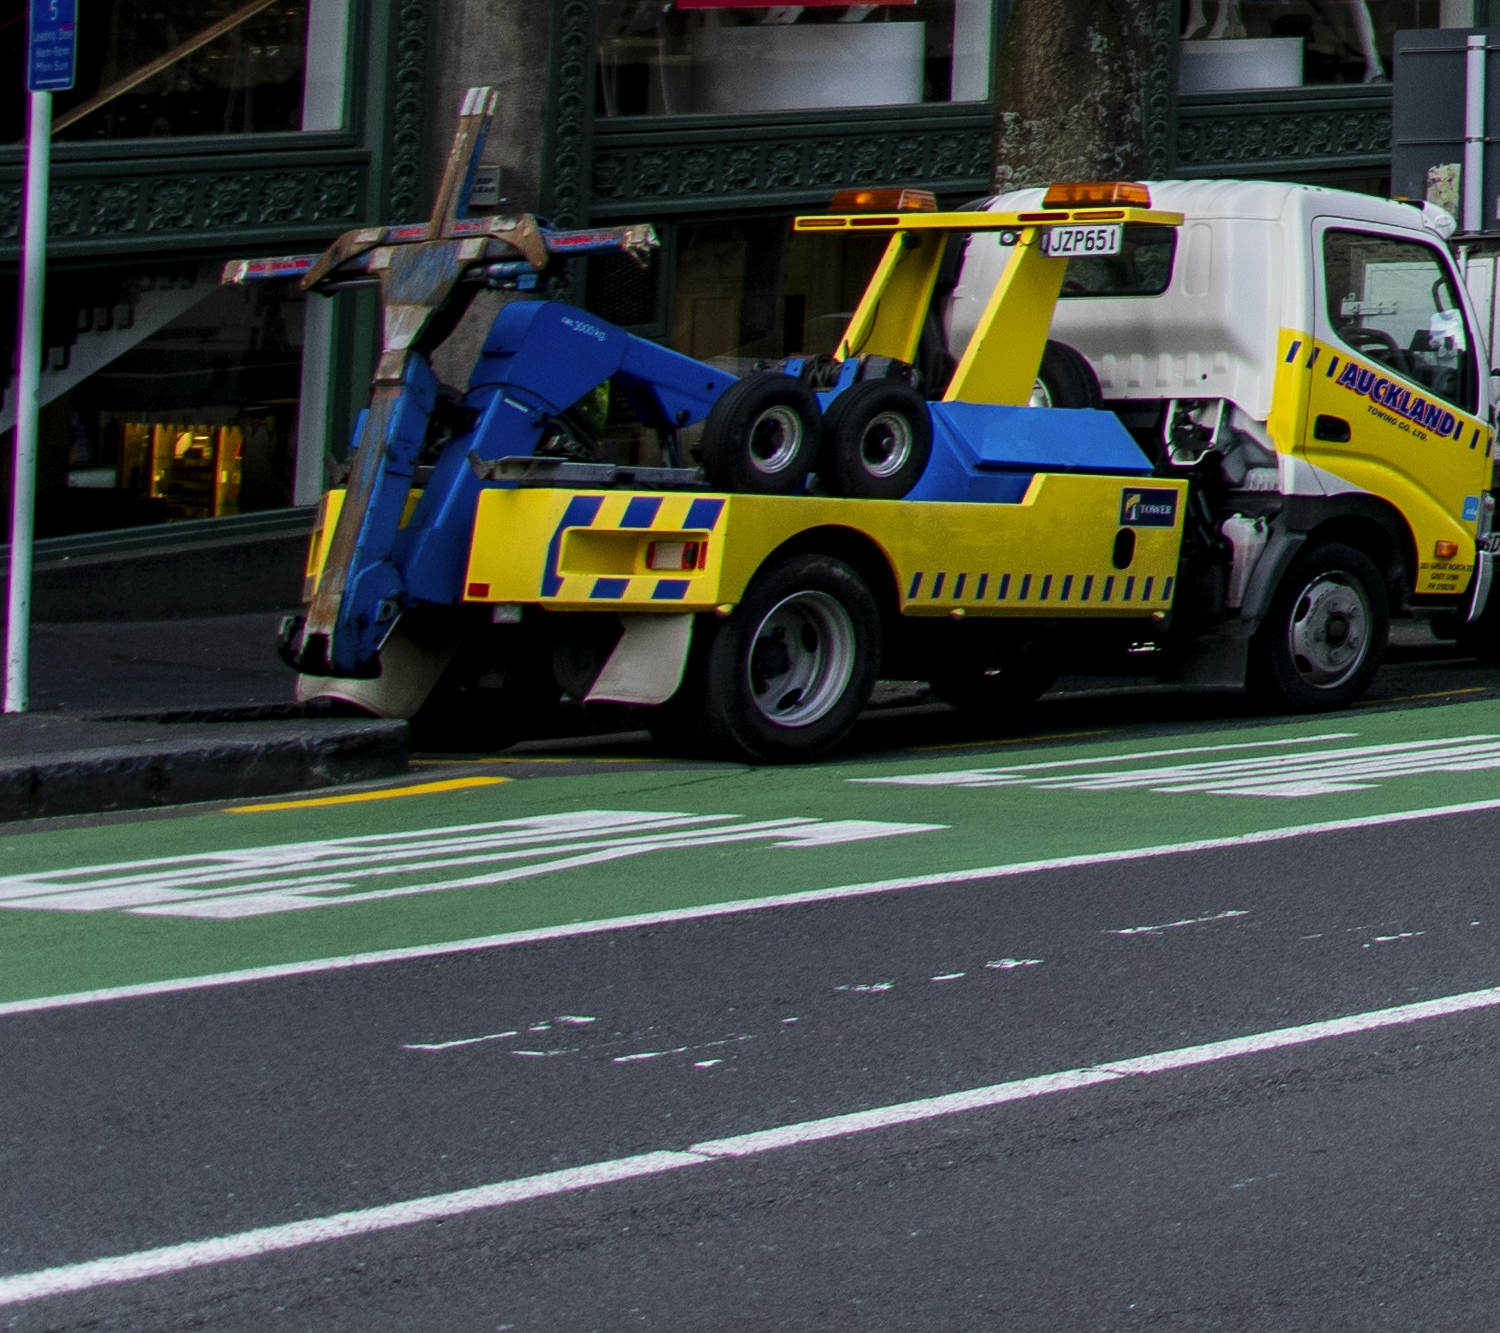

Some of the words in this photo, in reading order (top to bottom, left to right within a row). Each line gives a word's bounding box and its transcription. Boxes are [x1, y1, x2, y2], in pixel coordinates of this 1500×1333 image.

[50, 0, 59, 20] 5
[1051, 229, 1116, 252] JZP651
[1335, 361, 1456, 437] AUCKLAND
[1367, 405, 1398, 426] TOWING
[1398, 422, 1411, 434] CO.
[1412, 428, 1428, 442] LTD.
[1141, 504, 1173, 515] TOWER
